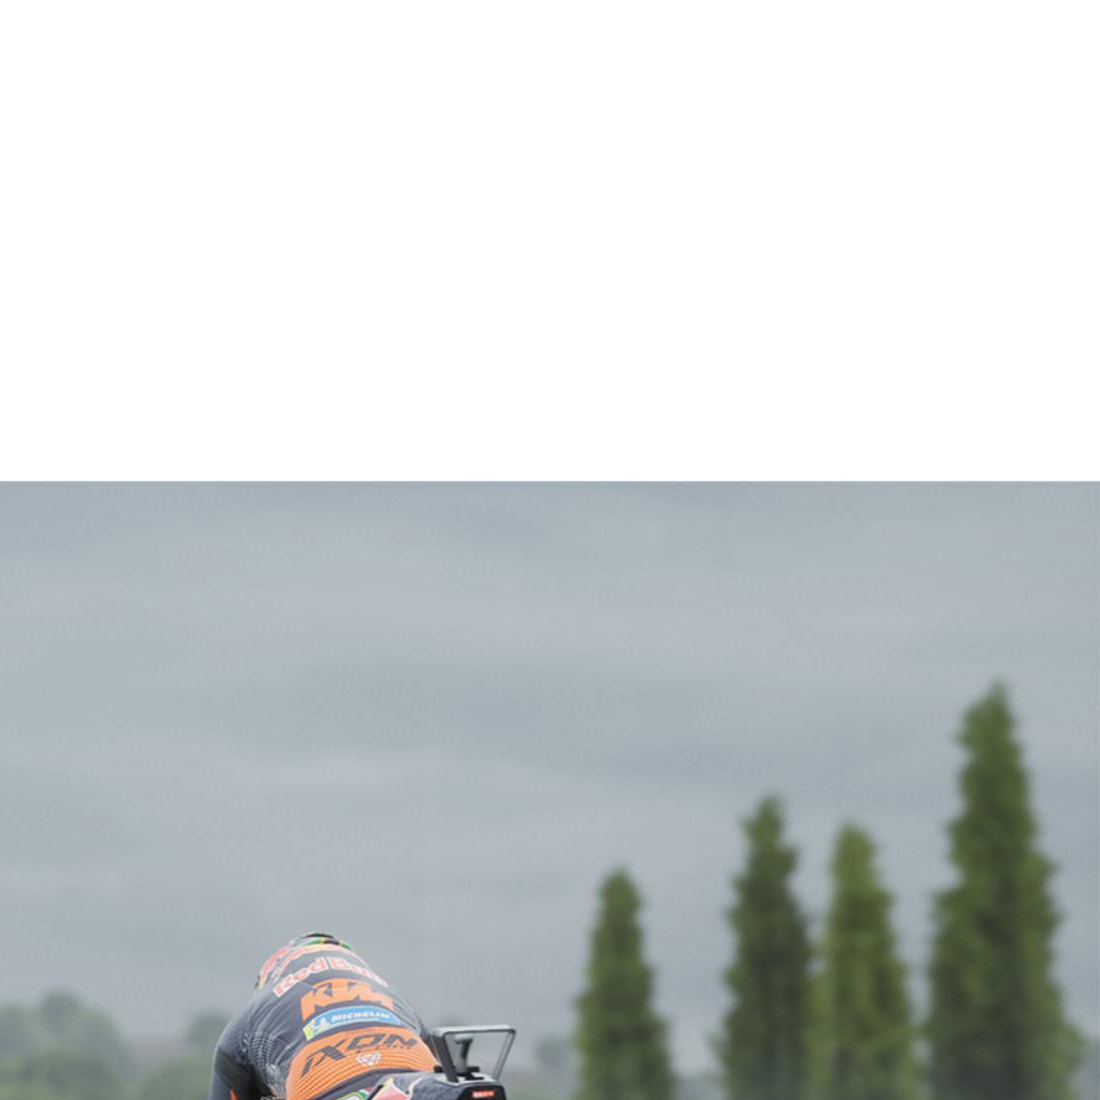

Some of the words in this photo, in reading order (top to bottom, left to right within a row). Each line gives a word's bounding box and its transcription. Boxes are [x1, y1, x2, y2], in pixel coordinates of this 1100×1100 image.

[273, 957, 329, 998] Red
[300, 977, 394, 1022] KTM
[331, 1010, 390, 1023] MICHELIN
